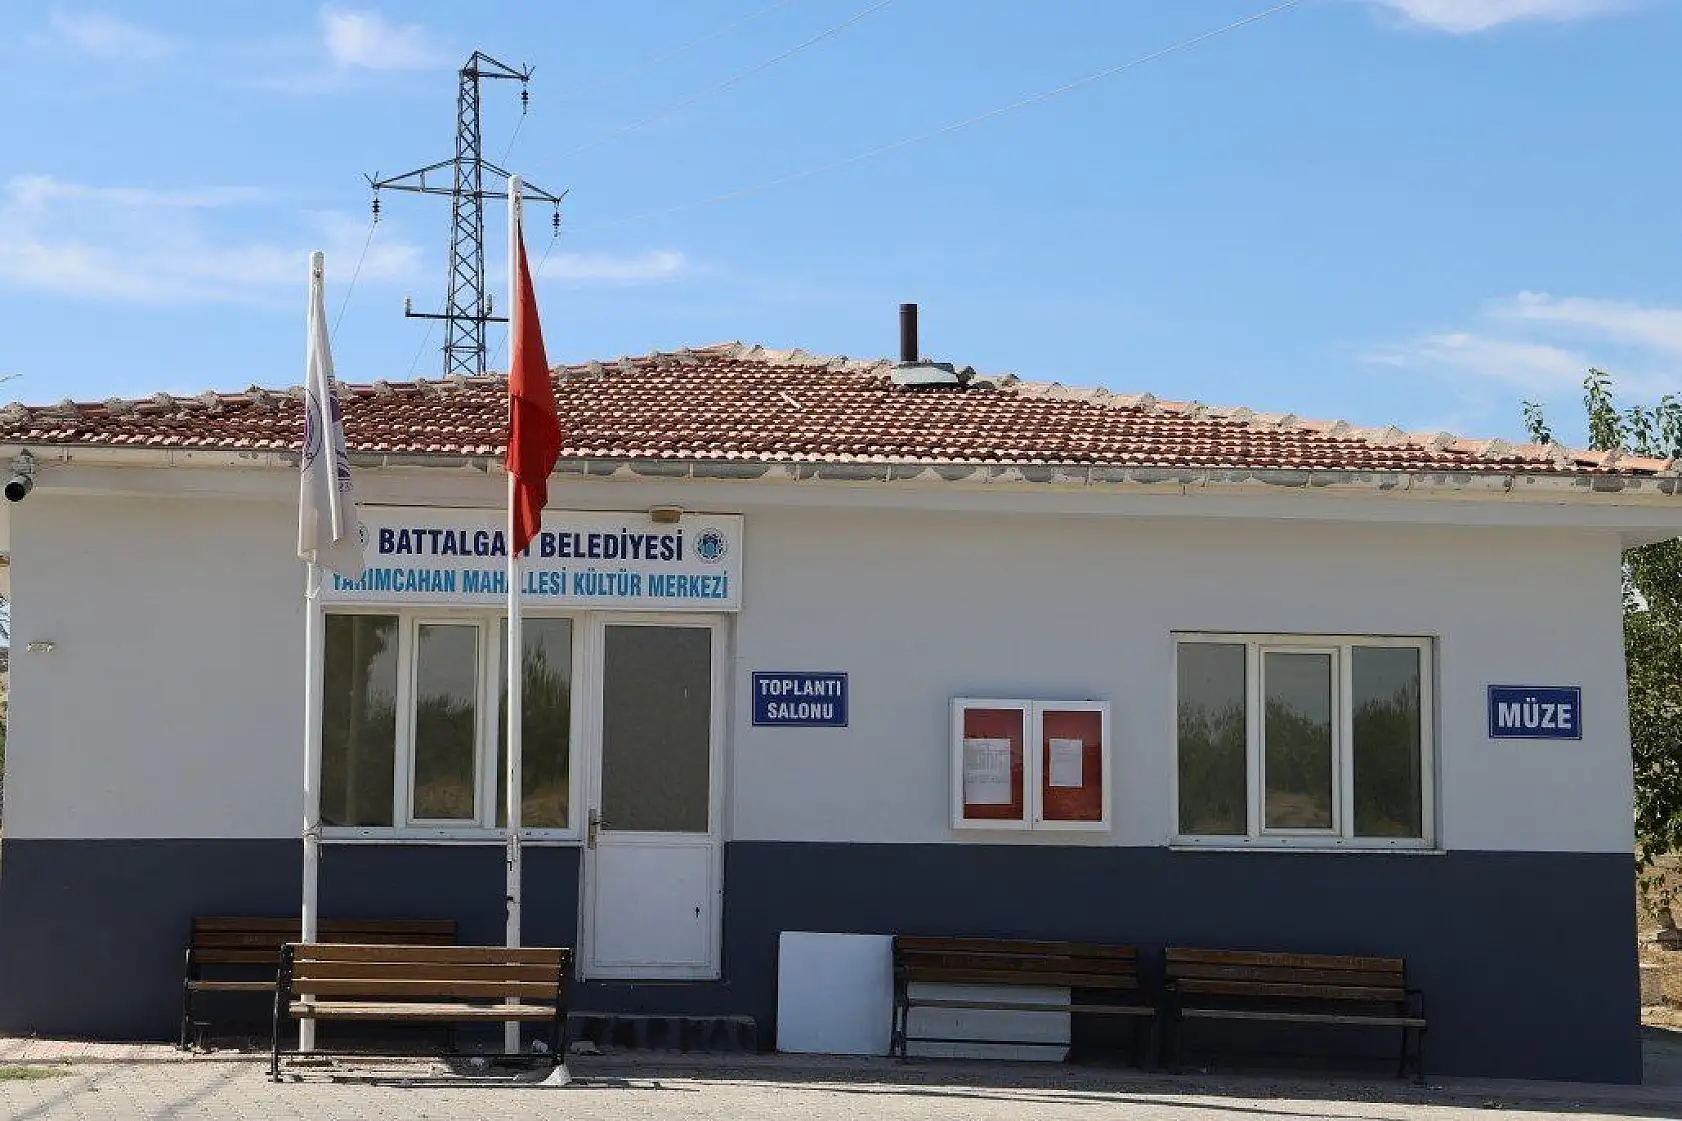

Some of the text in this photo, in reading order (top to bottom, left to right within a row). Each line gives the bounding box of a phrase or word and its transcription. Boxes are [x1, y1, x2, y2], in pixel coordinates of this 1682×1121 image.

[541, 527, 683, 561] BELEDİYESİ
[573, 567, 641, 597] KÜLTÜR
[648, 570, 728, 599] MERKEZİ
[759, 679, 841, 697] TOPLANTI
[767, 702, 833, 720] SALONU
[1498, 697, 1572, 728] MÜZE
